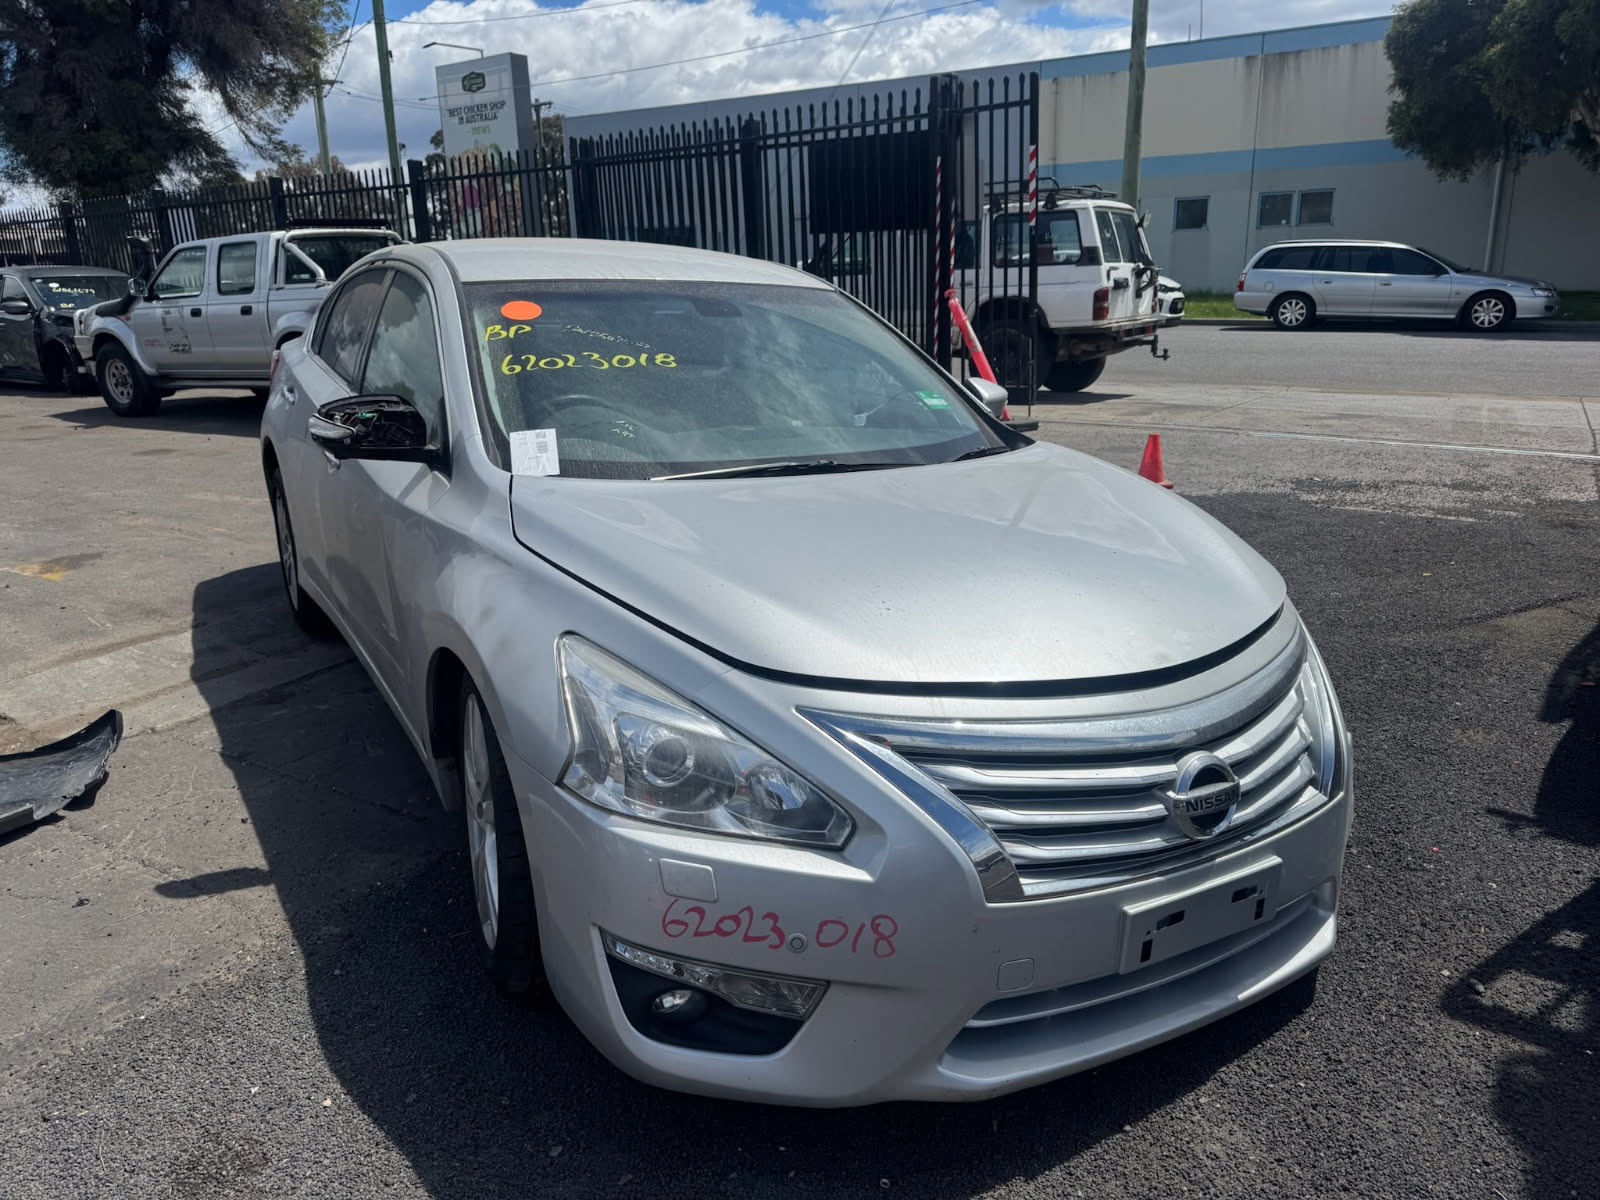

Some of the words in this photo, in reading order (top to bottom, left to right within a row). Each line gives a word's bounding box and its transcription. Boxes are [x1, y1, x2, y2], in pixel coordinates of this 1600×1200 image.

[463, 103, 489, 115] CHICKEN
[489, 100, 506, 111] SHOP
[458, 116, 464, 125] IN
[485, 325, 532, 341] BP
[501, 352, 678, 375] 62023018
[1186, 789, 1240, 812] NISSAN
